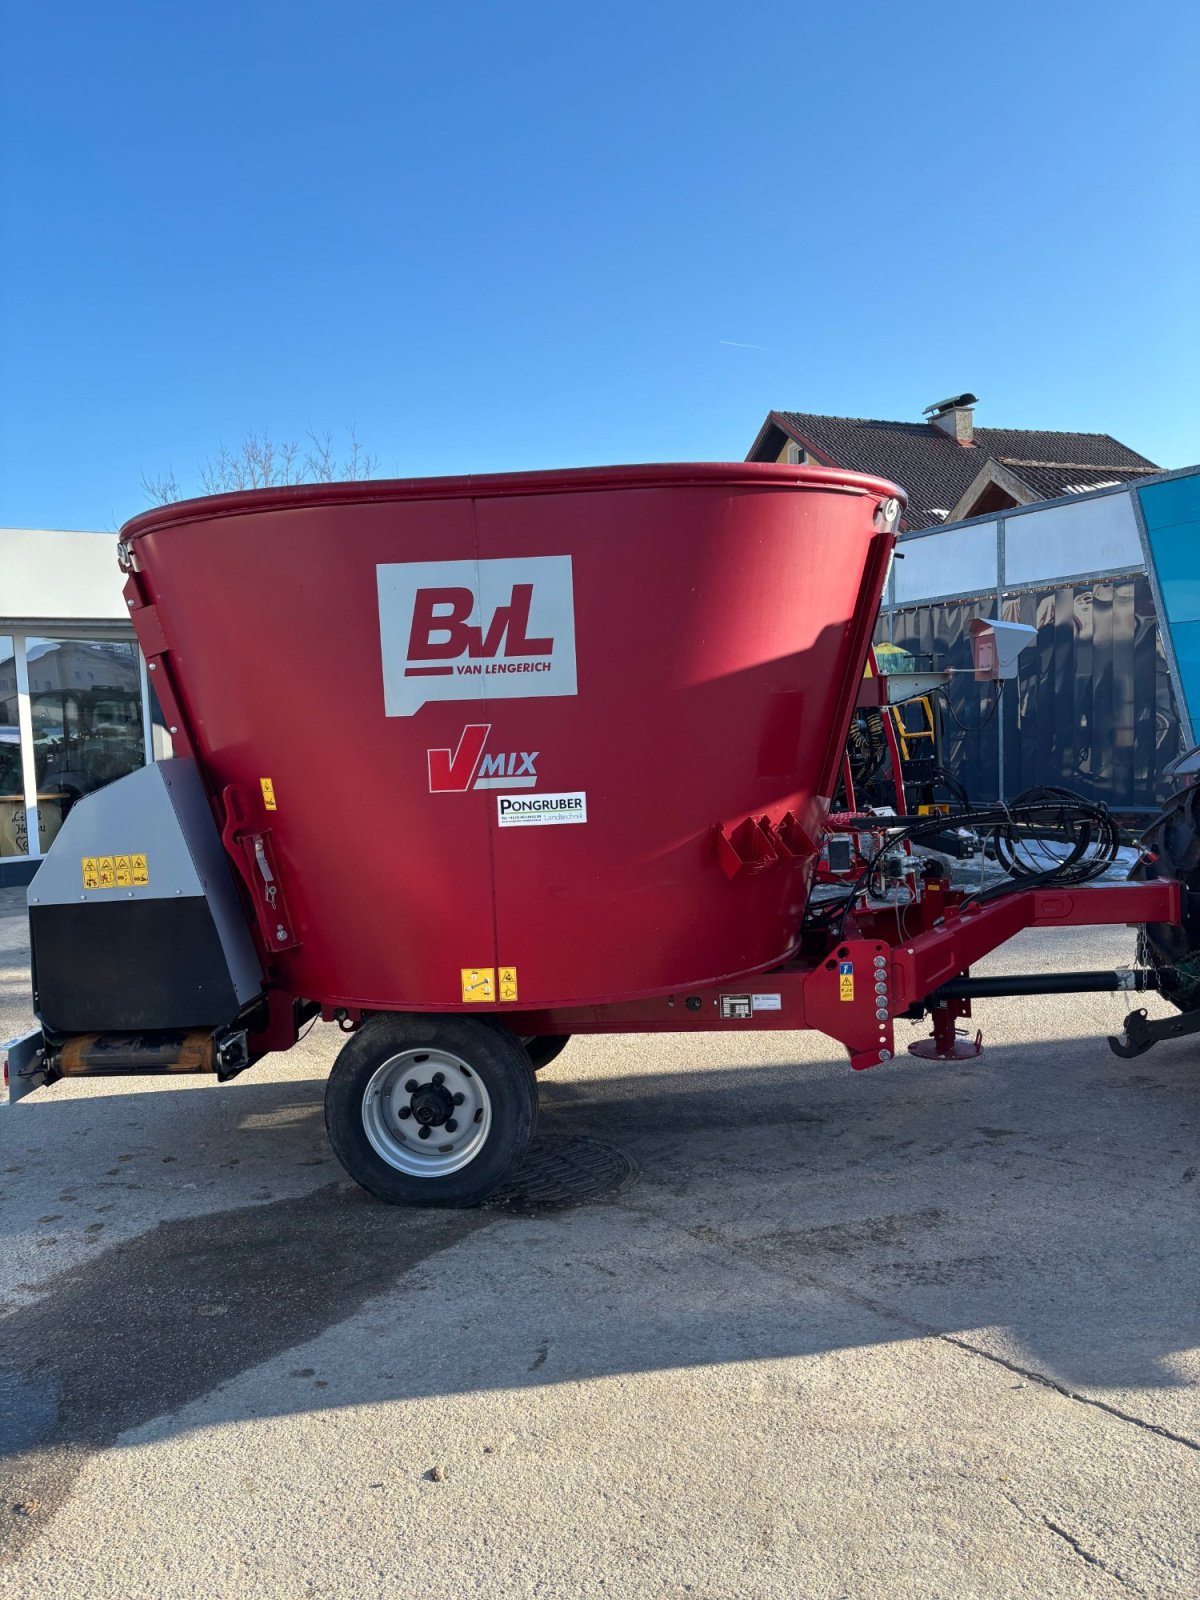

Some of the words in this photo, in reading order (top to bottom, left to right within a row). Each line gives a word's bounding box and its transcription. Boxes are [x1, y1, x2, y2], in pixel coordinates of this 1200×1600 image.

[457, 665, 482, 675] VAN
[485, 662, 551, 674] LENGERICH
[500, 798, 583, 815] PONGRUBER
